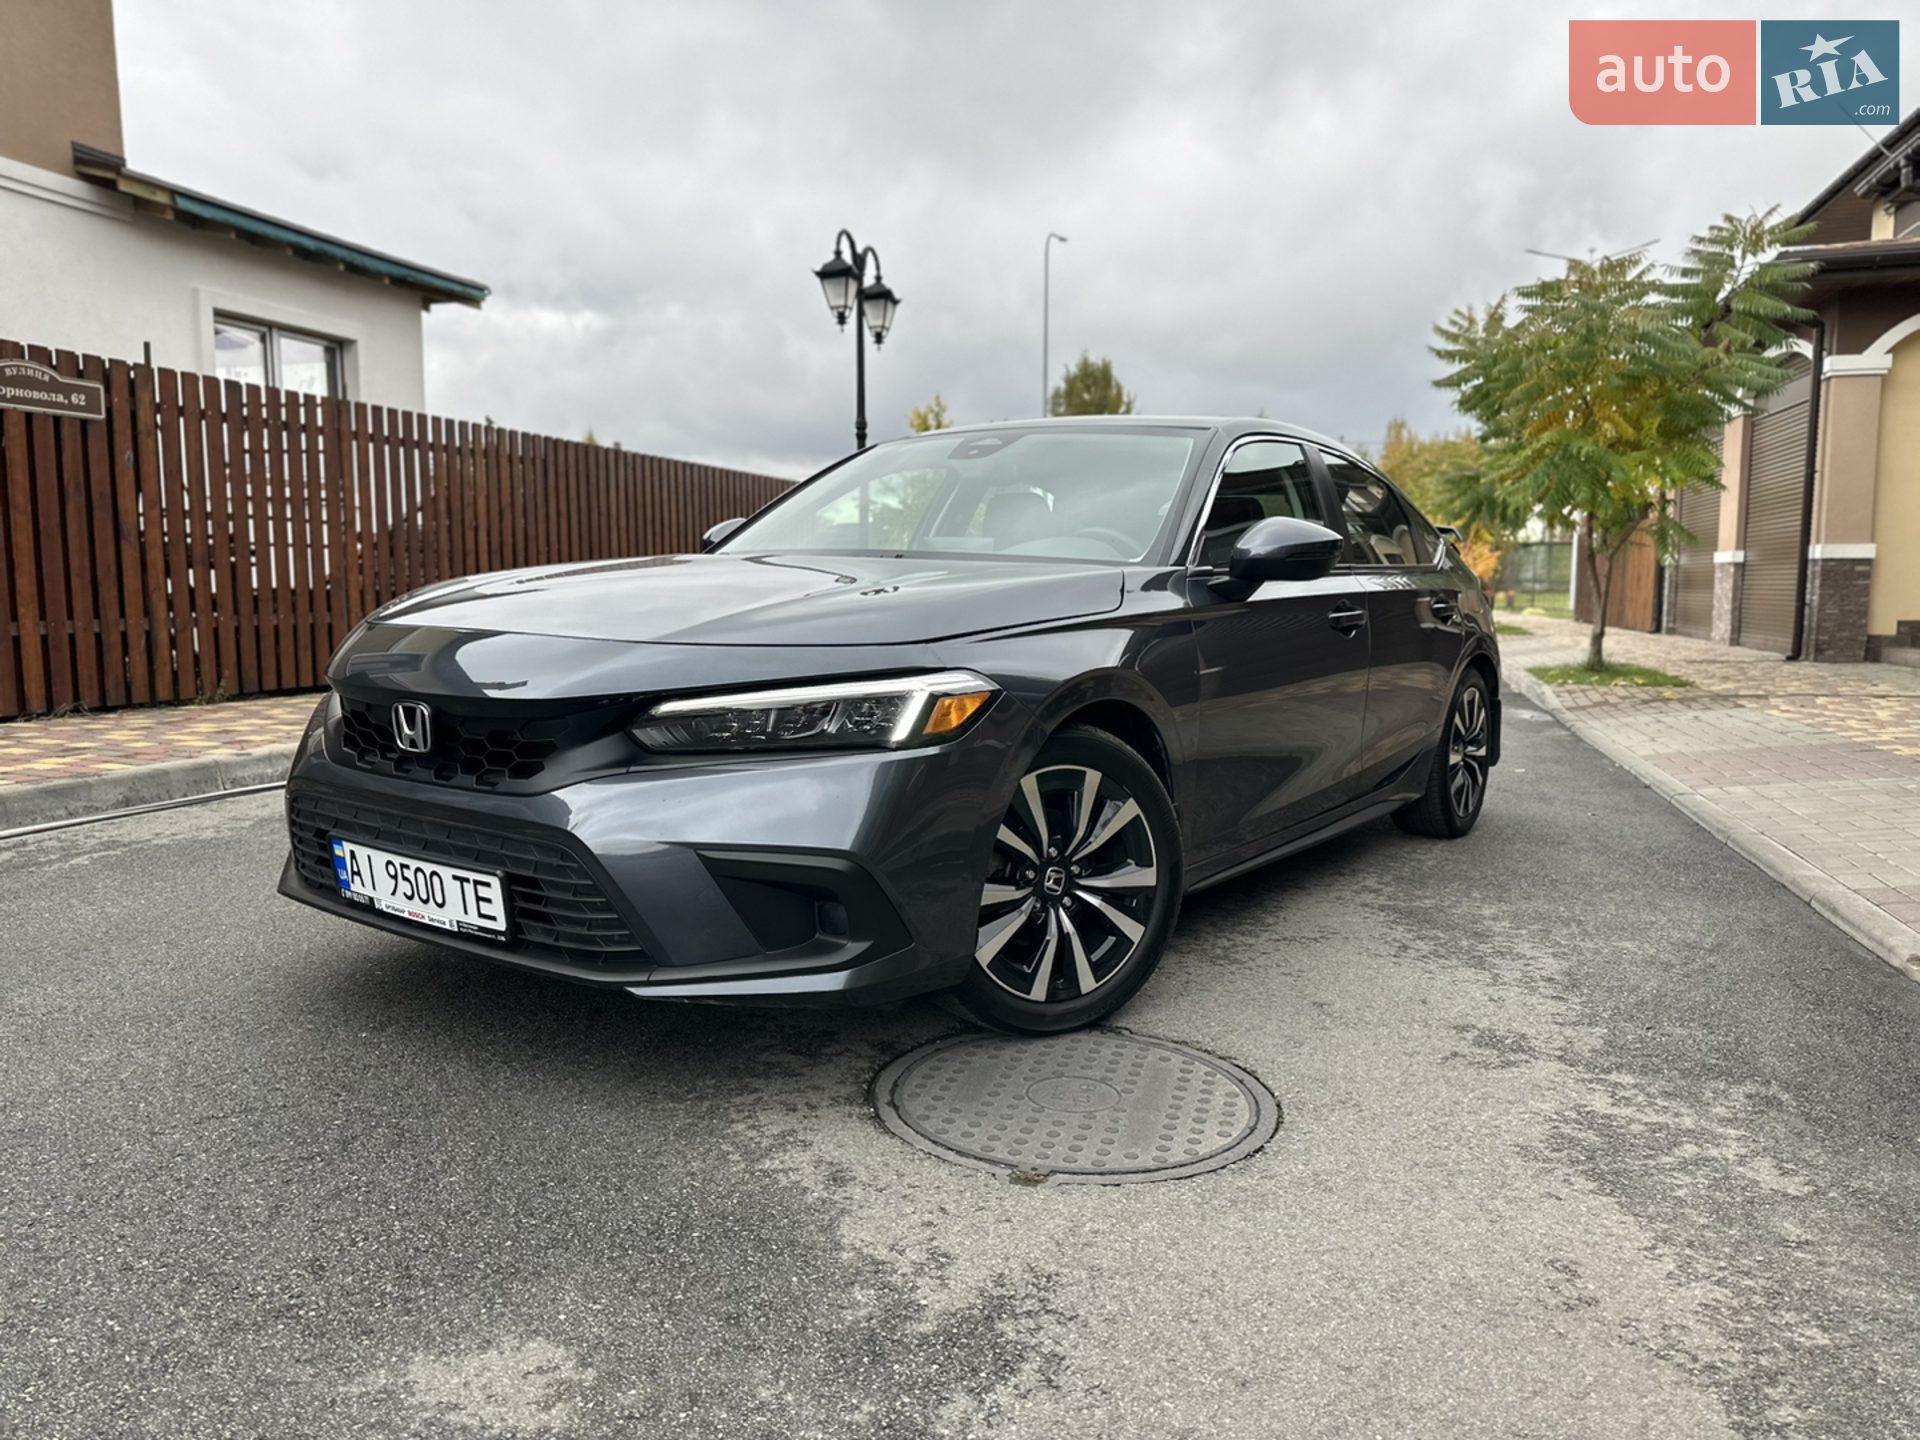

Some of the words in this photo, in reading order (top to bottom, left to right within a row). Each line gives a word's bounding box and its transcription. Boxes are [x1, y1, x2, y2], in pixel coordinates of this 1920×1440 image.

[71, 392, 86, 406] 62
[349, 849, 376, 891] AI
[385, 859, 446, 909] 9500
[452, 874, 498, 922] TE
